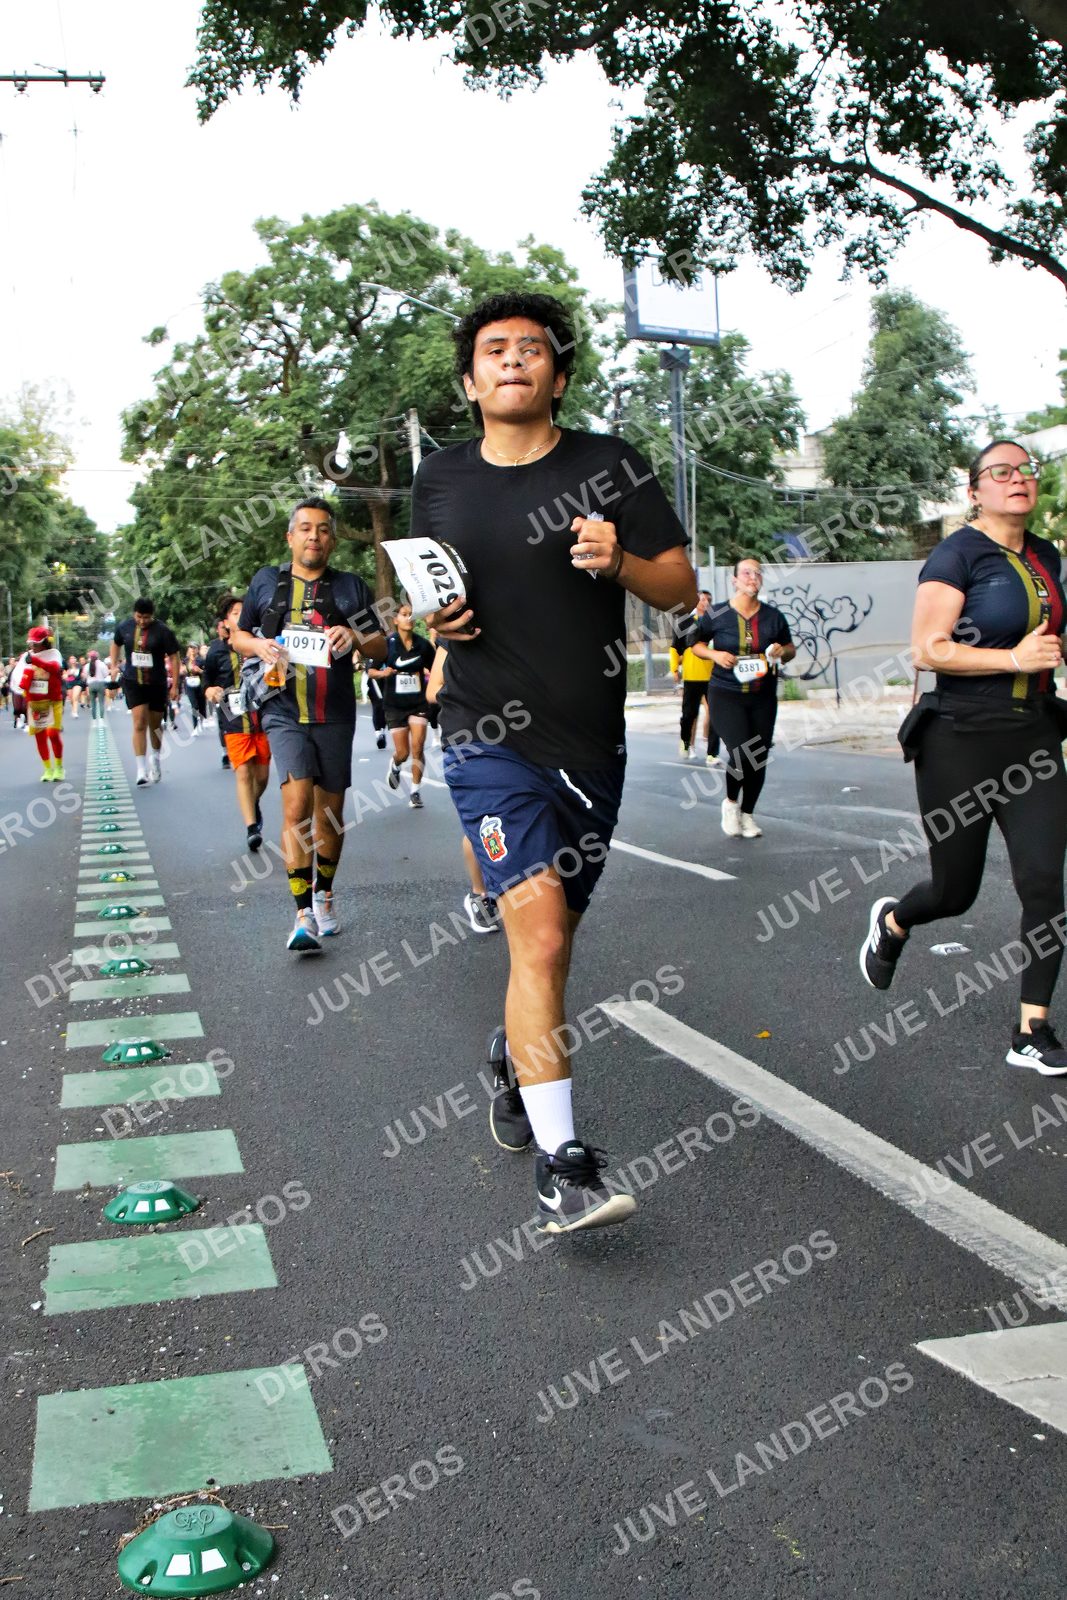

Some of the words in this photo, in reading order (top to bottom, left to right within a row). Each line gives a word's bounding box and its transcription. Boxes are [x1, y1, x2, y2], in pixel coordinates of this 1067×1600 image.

[768, 584, 811, 600] TOY
[285, 636, 326, 651] 10917
[738, 662, 760, 673] 6381
